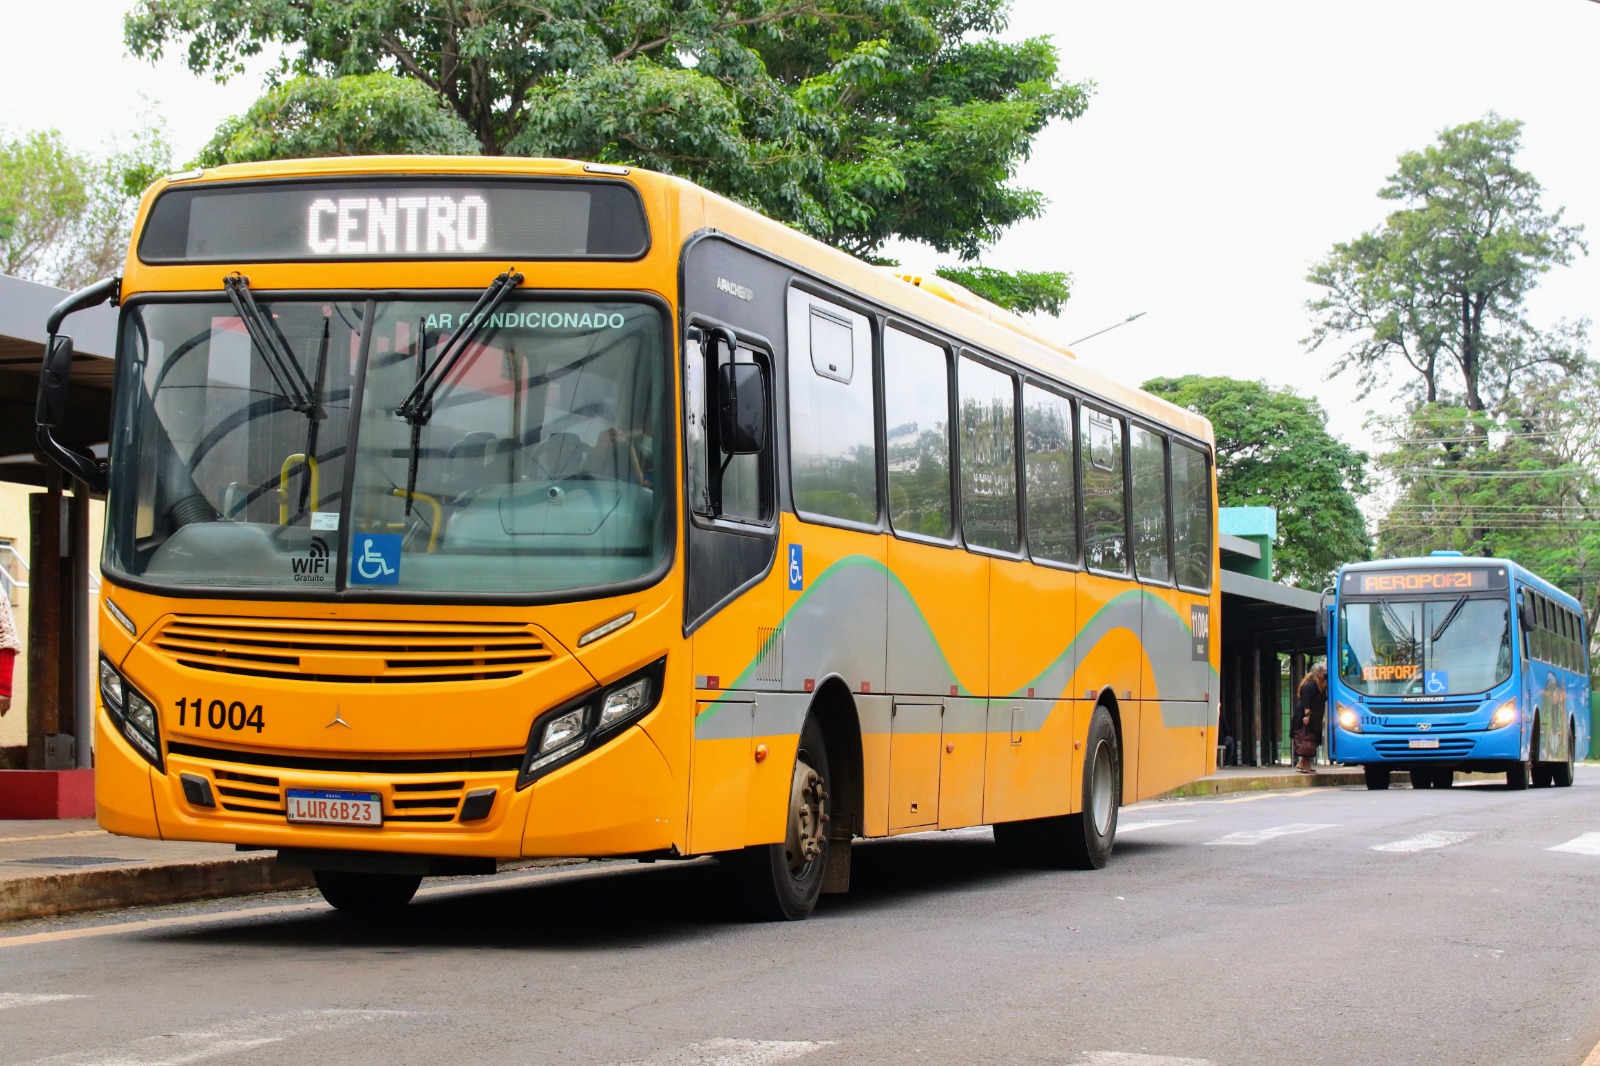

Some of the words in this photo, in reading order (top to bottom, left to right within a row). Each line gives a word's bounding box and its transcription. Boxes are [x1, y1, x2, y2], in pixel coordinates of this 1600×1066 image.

[308, 195, 488, 254] CENTRO
[424, 312, 452, 329] AR
[458, 311, 626, 329] CONDICIONADO
[294, 574, 325, 583] Gratuito
[1362, 664, 1419, 681] AIRPORT
[175, 697, 265, 734] 11004
[1360, 715, 1389, 725] 11017
[296, 799, 373, 822] LUR6B23
